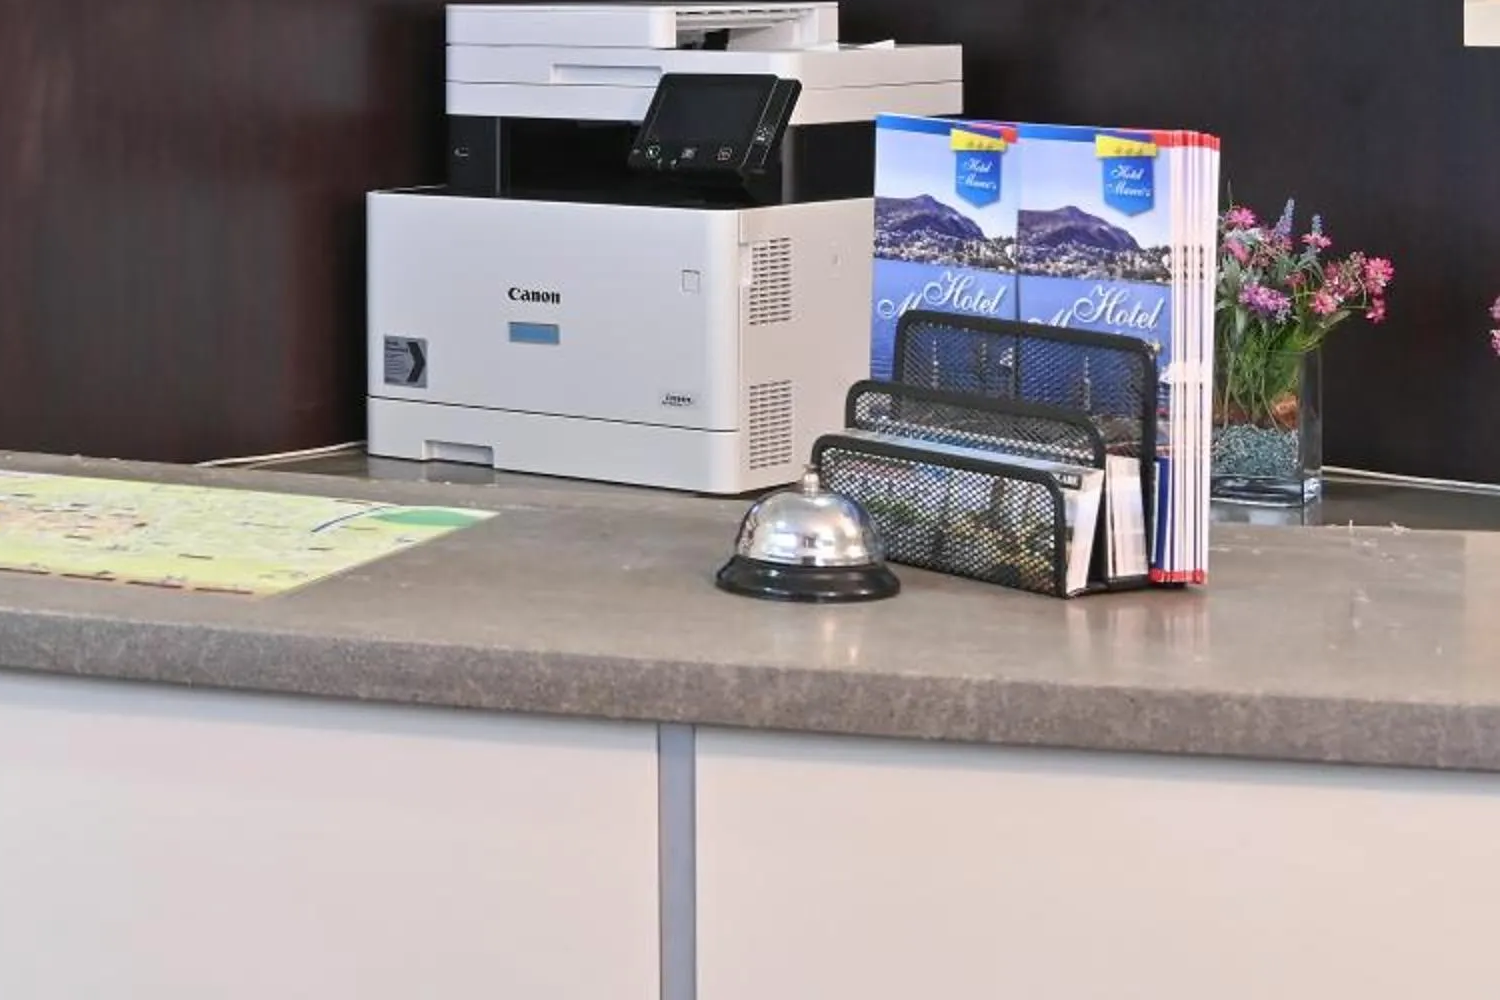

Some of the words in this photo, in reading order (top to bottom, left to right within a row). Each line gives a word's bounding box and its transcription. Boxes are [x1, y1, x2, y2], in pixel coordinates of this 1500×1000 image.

[1111, 164, 1145, 180] Hotel
[508, 286, 561, 305] Canon
[923, 271, 1007, 315] Hotel
[1073, 284, 1165, 330] Hotel
